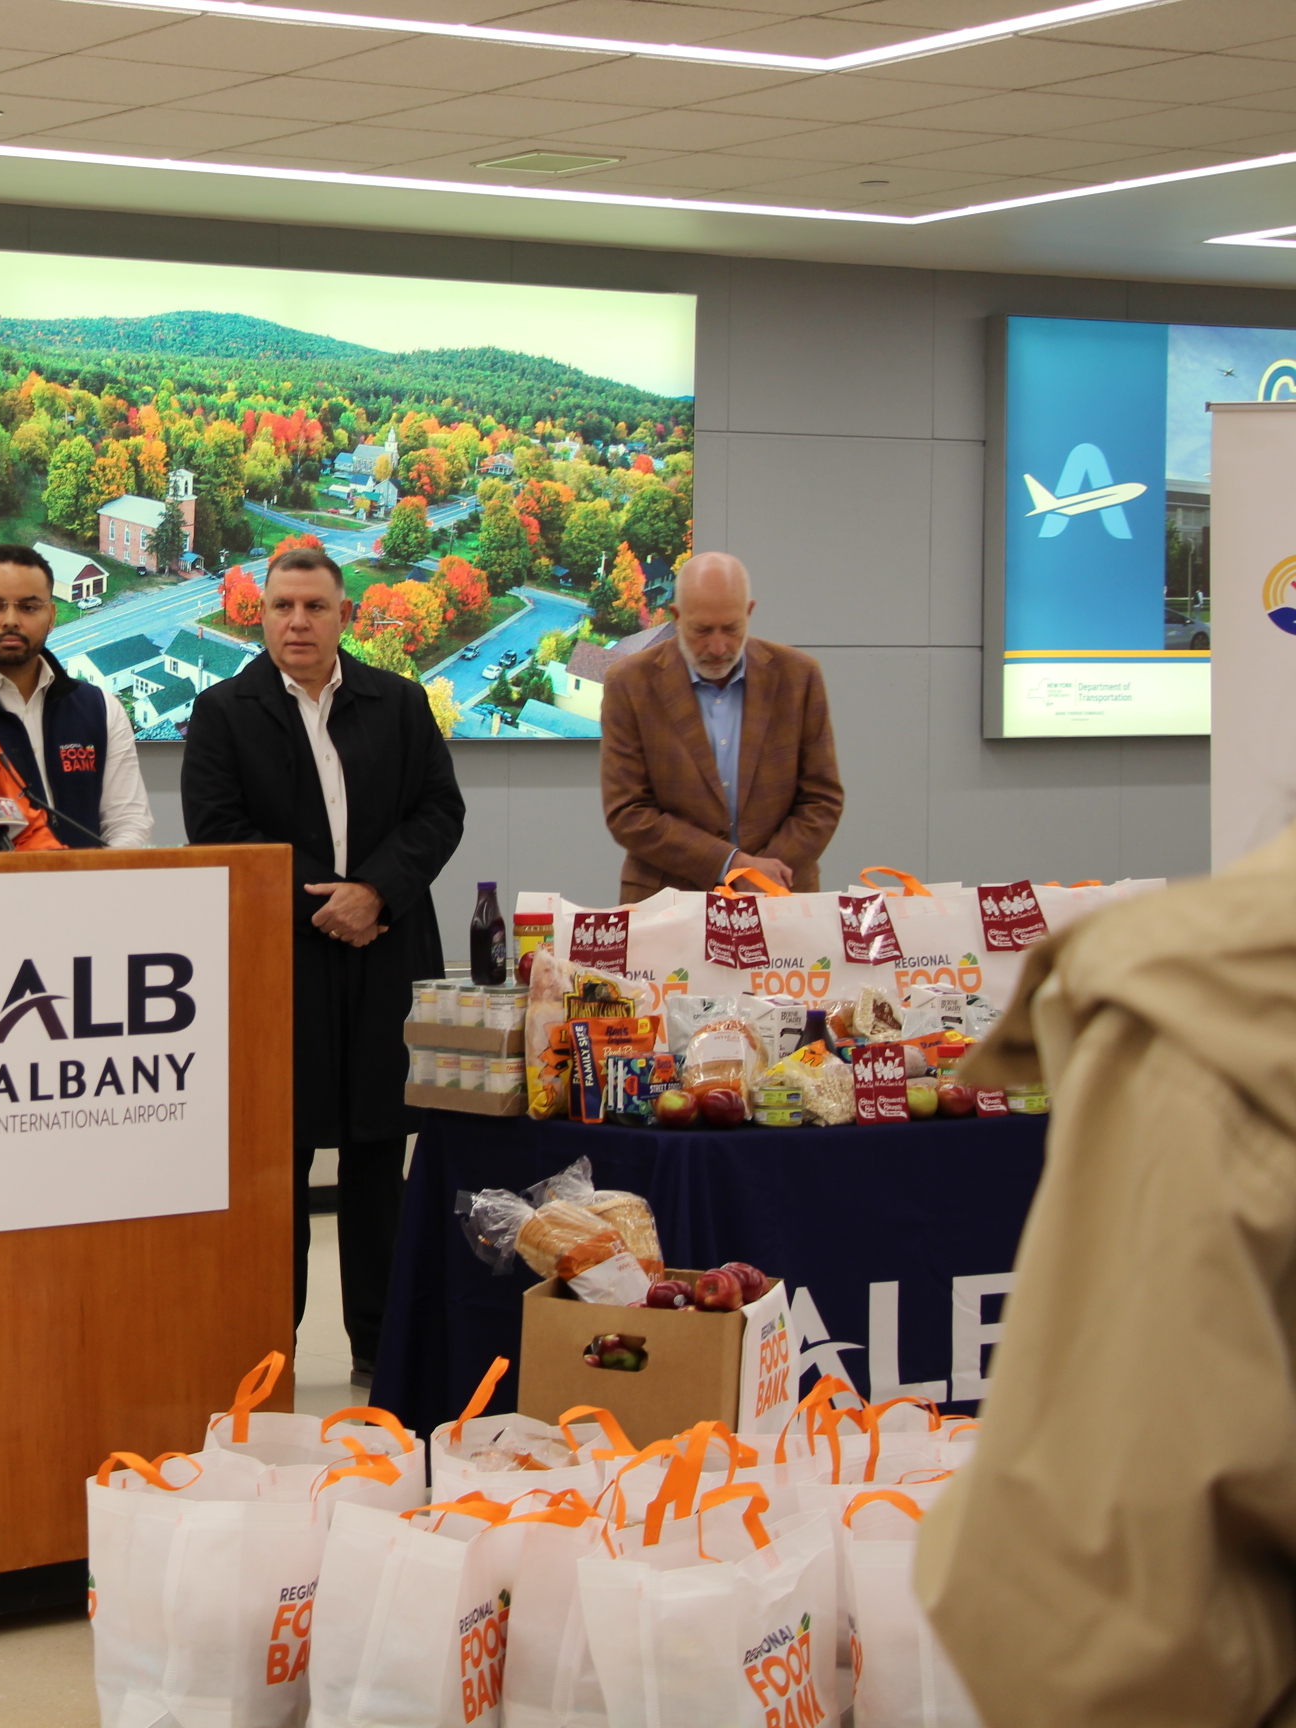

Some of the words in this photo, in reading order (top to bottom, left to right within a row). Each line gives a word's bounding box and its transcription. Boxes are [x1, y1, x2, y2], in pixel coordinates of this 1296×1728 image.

[1077, 682, 1122, 694] Department
[1122, 681, 1131, 691] of
[1077, 692, 1133, 704] Transportation
[59, 748, 95, 760] FOOD
[63, 759, 96, 772] BANK
[894, 954, 952, 969] REGIONAL
[750, 970, 831, 998] FOOD
[894, 966, 983, 998] FOOD
[574, 1025, 588, 1046] SIZE
[581, 1049, 594, 1087] FAMILY
[649, 1084, 667, 1094] STREET
[877, 1095, 907, 1104] Stewart's
[122, 1102, 188, 1125] AIRPORT
[883, 1102, 903, 1111] Shops
[759, 1330, 790, 1380] FOOD
[754, 1364, 791, 1419] BANK
[459, 1599, 495, 1636] REGIONAL
[743, 1624, 796, 1666] REGIONAL
[744, 1631, 810, 1708] FOOD
[765, 1674, 826, 1728] BANK
